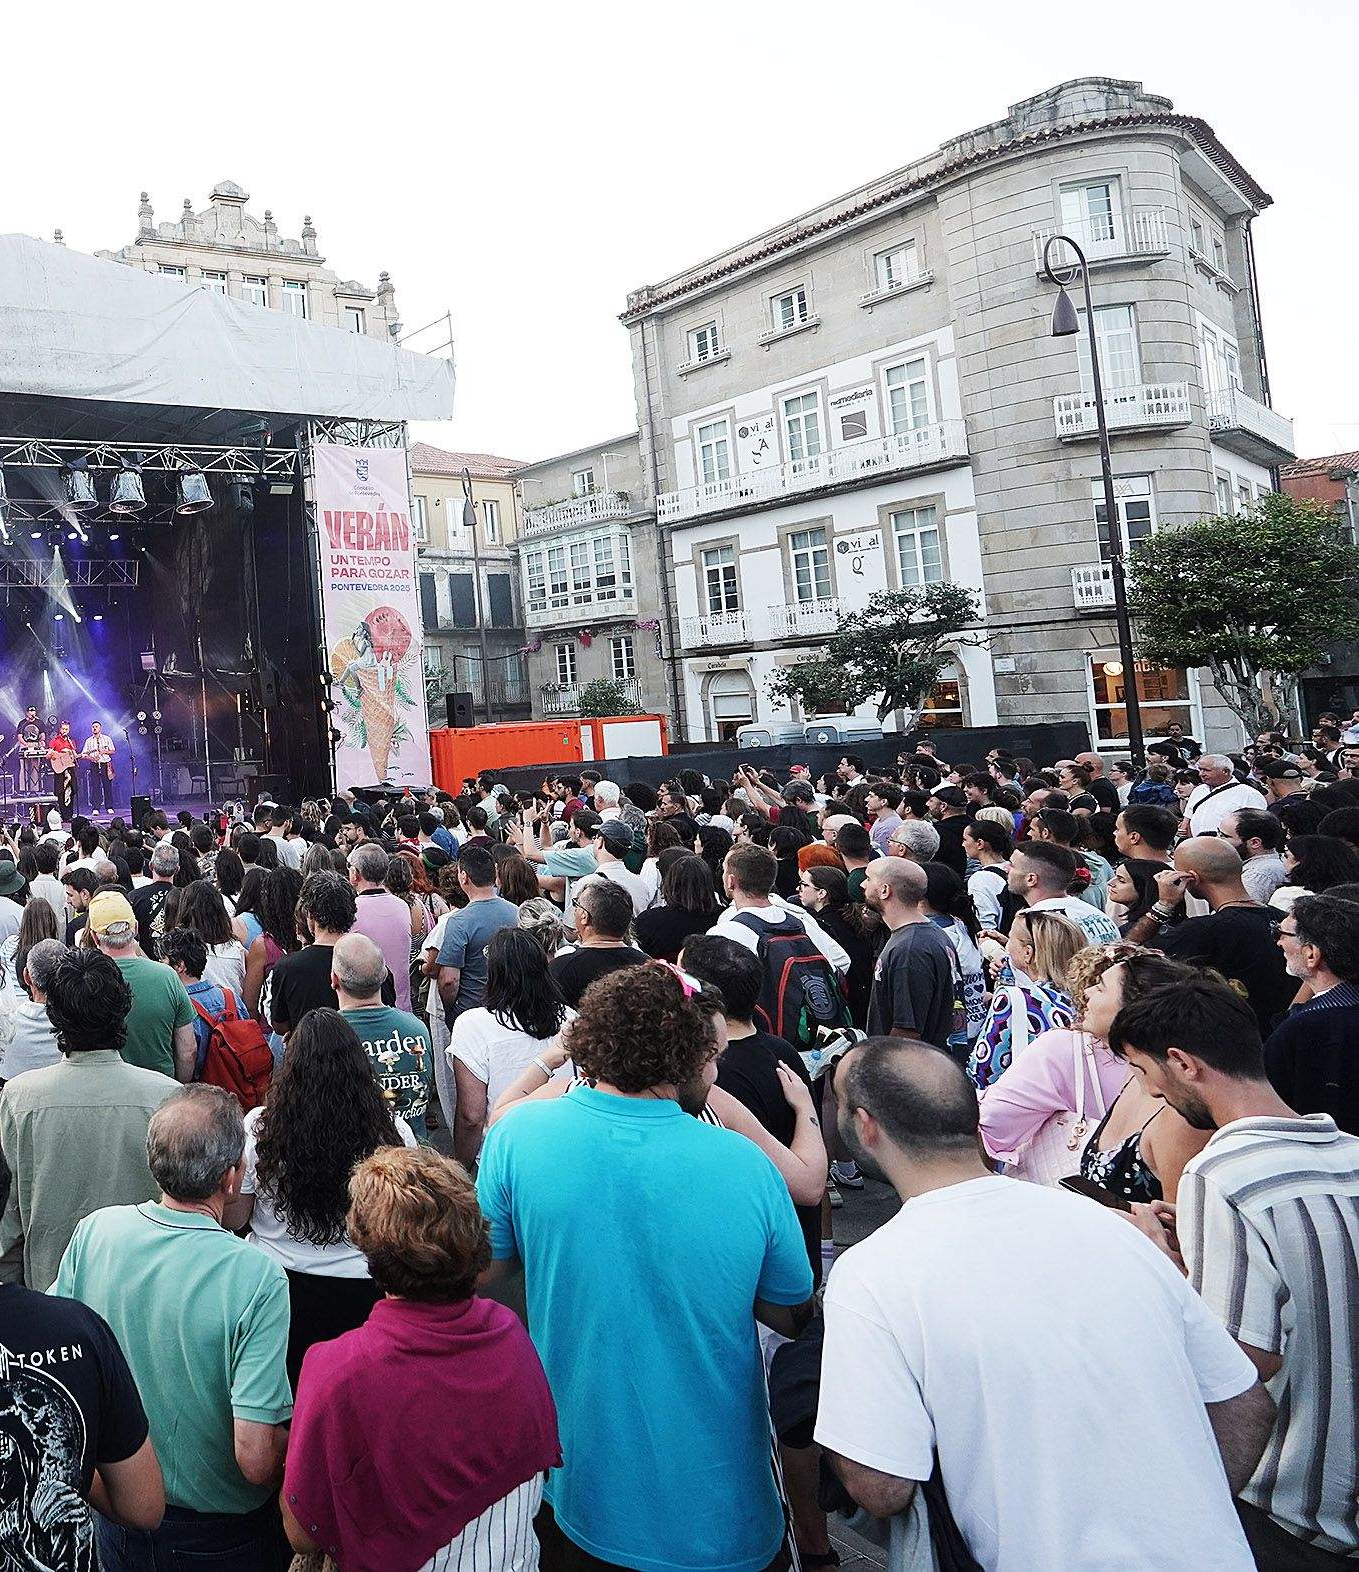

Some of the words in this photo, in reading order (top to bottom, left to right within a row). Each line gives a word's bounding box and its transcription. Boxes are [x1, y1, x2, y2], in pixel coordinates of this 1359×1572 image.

[323, 502, 409, 551] VERÁN
[330, 554, 349, 565] UN
[350, 555, 391, 566] TEMPO
[331, 567, 367, 578] PARA
[368, 568, 409, 579] GOZAR
[331, 583, 390, 592] PONTEVEDRA
[390, 584, 411, 592] 2025
[362, 1029, 428, 1057] arden
[378, 1074, 420, 1091] NDER
[16, 1344, 83, 1369] TOKEN
